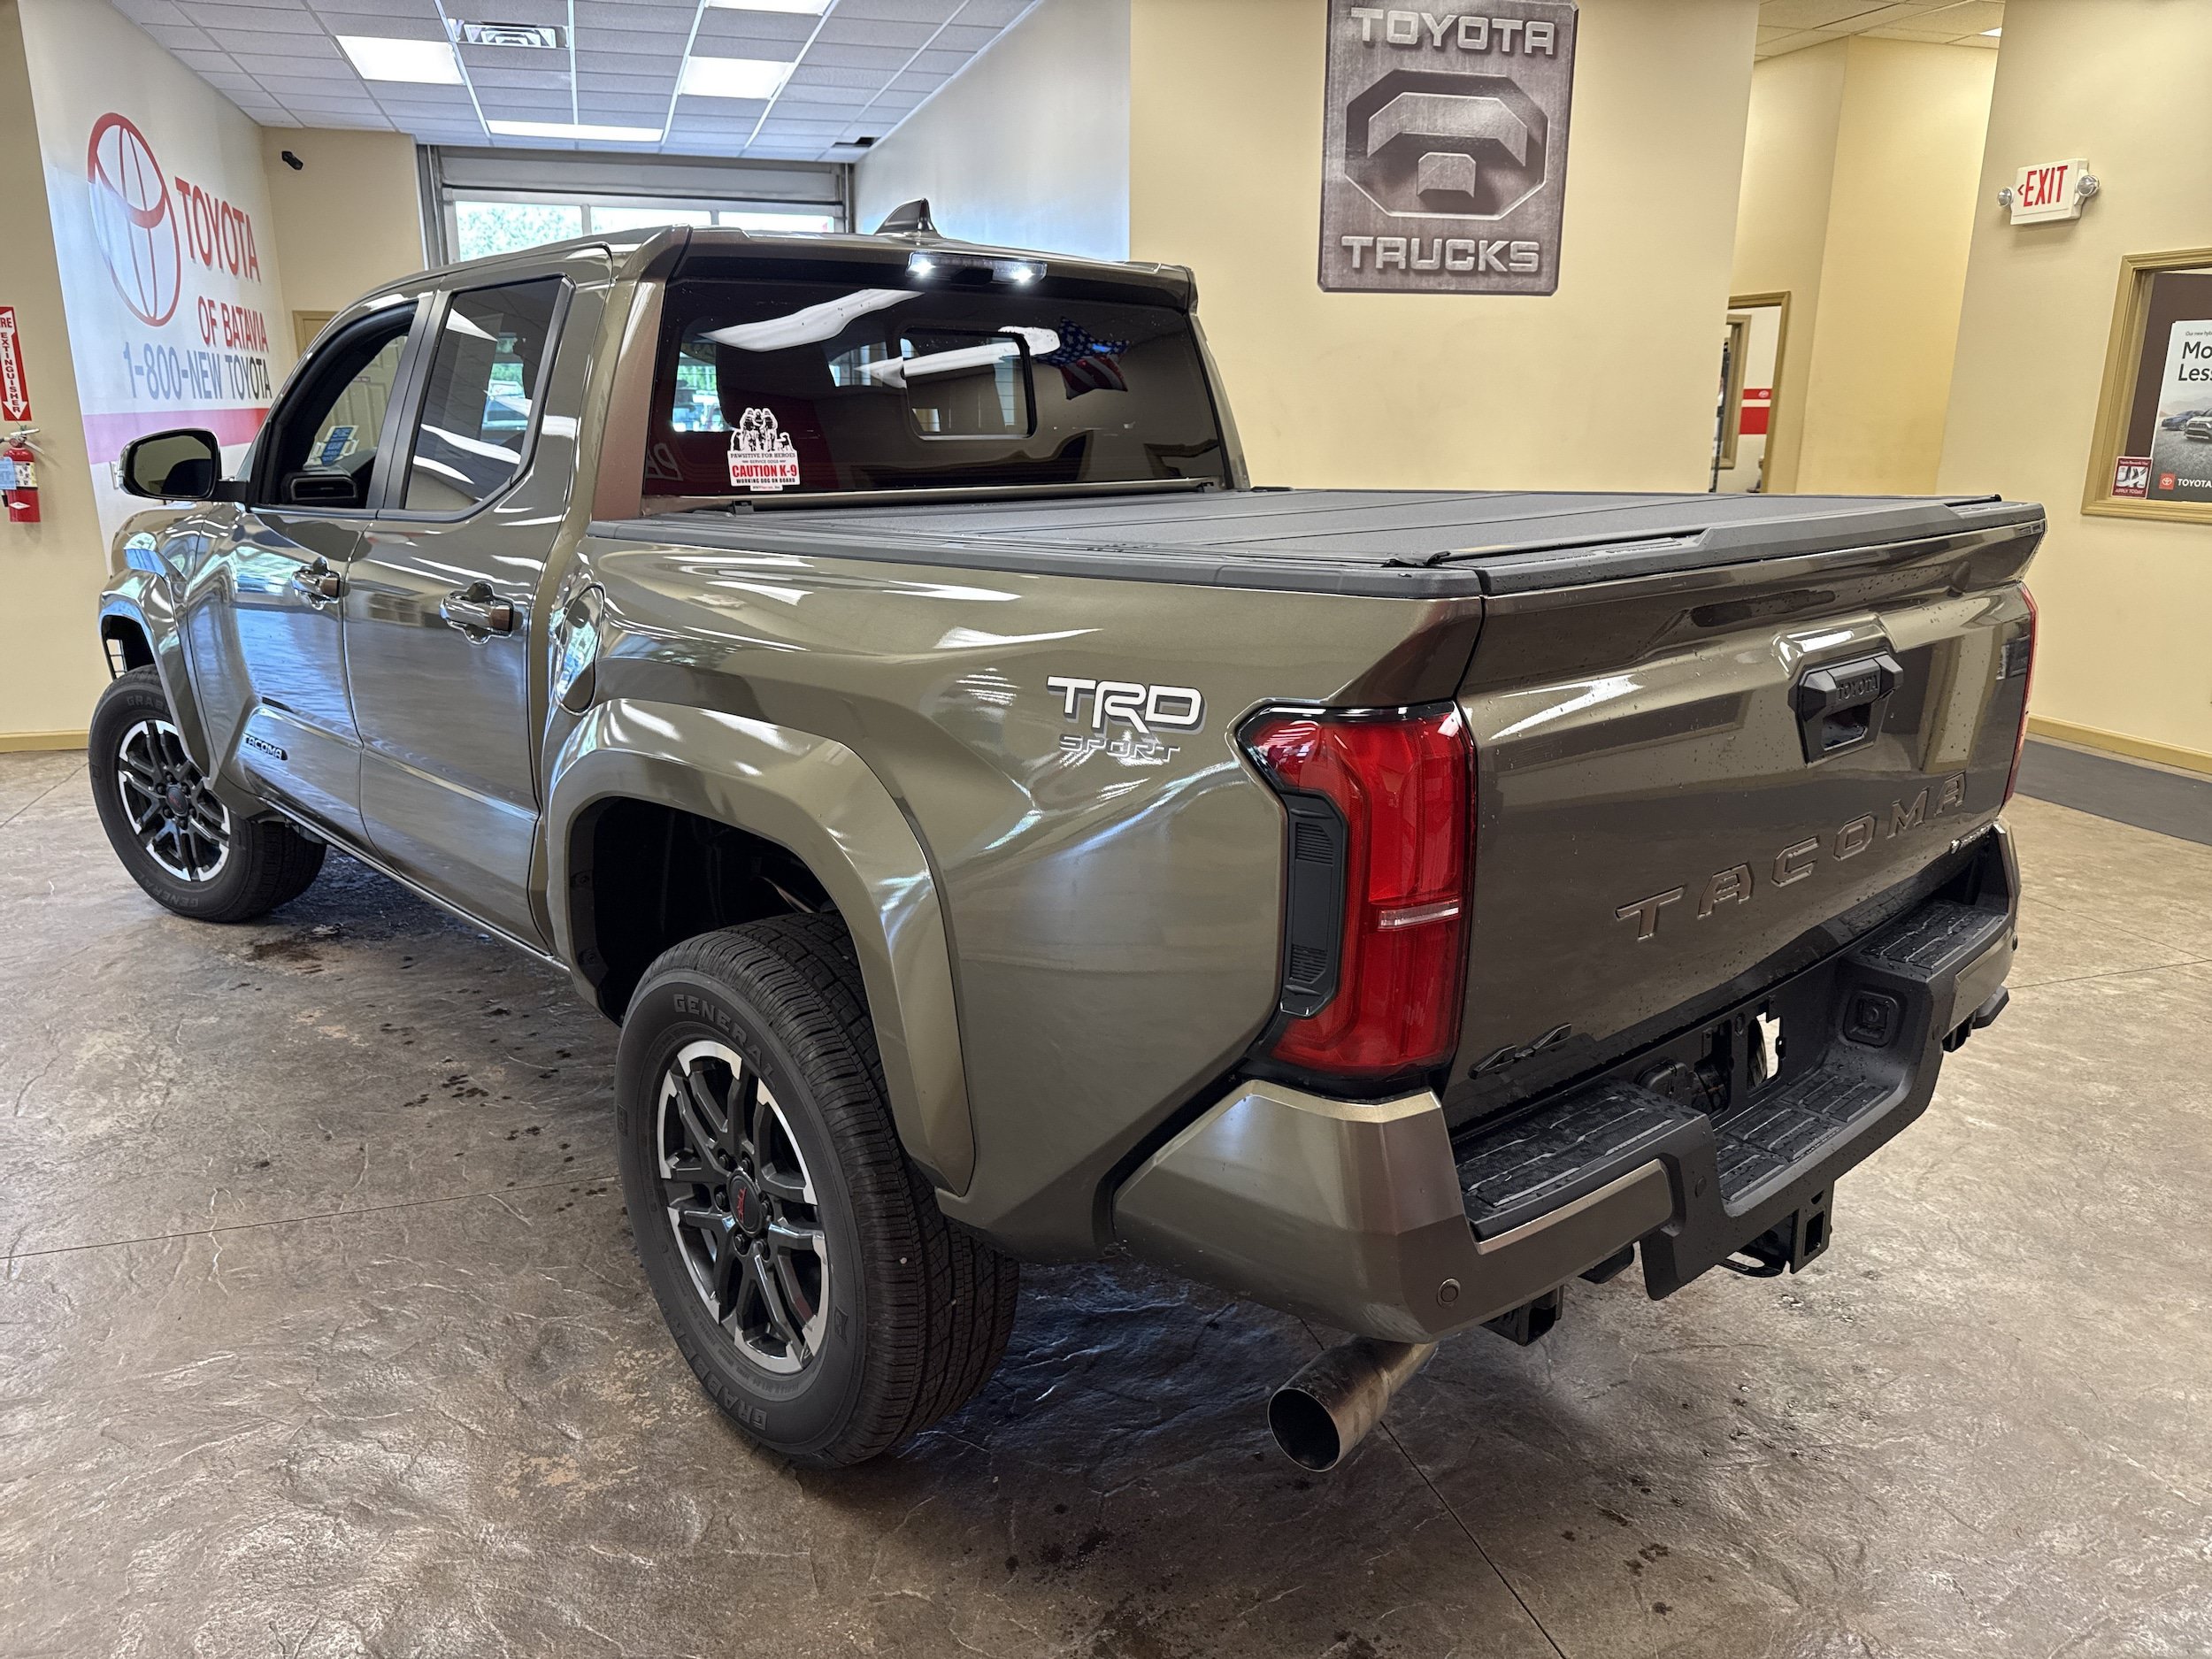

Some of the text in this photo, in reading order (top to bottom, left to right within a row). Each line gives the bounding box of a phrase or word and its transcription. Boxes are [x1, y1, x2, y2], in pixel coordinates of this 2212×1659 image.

[1350, 7, 1555, 55] TOYOTA
[2024, 165, 2068, 207] EXIT
[174, 176, 261, 283] TOYOTA
[1341, 235, 1540, 273] TRUCKS
[198, 296, 270, 353] OF BATAVIA
[1, 332, 21, 413] EXTINGUISHER
[123, 342, 273, 401] 1-800-NEW TOYOTA
[732, 464, 797, 478] CAUTION K-9
[2177, 478, 2212, 488] TOYOTA
[1047, 676, 1203, 734] TRD
[1838, 674, 1878, 702] TOYOTA
[242, 733, 283, 760] TACOMA
[1059, 734, 1181, 764] SPORT
[1615, 770, 1968, 941] TACOMA
[673, 994, 777, 1090] GENERAL
